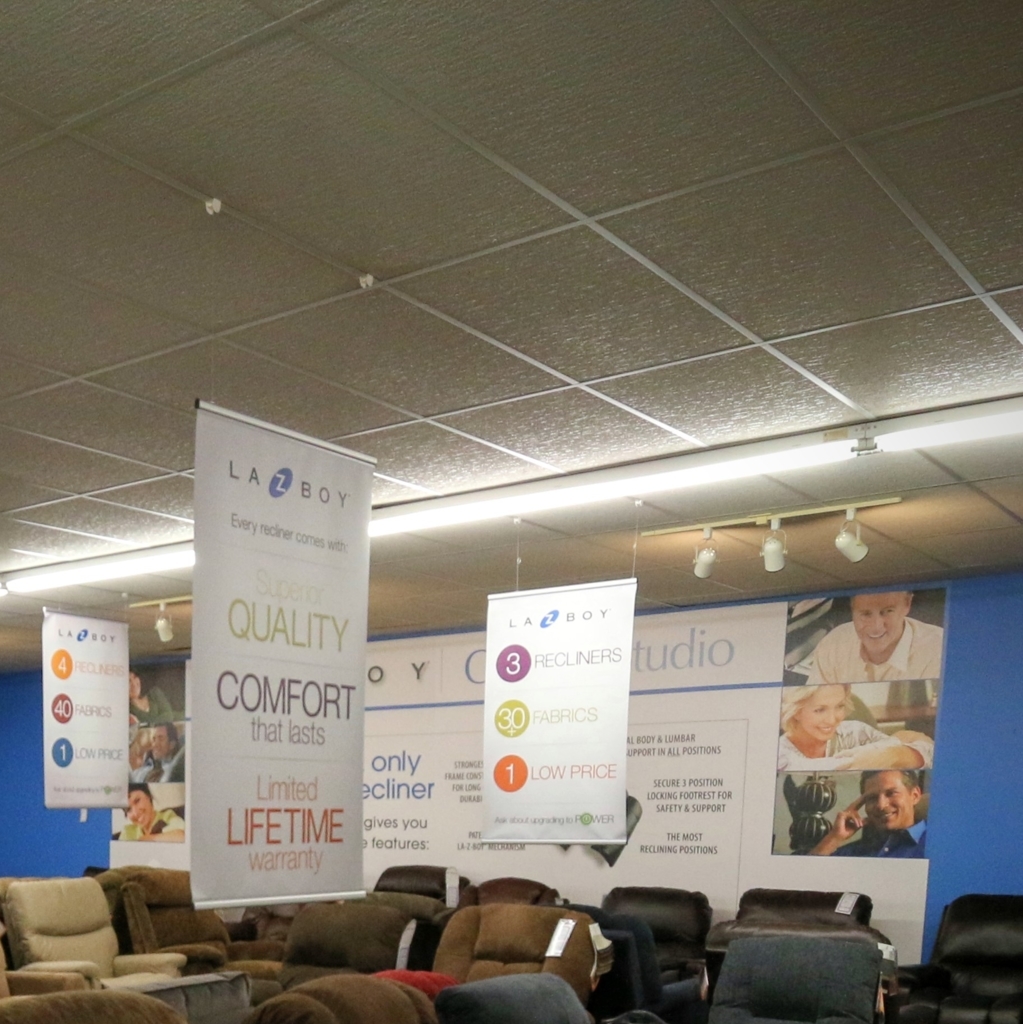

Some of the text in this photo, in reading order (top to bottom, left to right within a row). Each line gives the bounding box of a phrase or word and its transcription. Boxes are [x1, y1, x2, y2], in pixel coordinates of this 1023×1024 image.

[231, 513, 349, 554] Every recliner comes with:
[228, 598, 349, 652] QUALITY
[633, 627, 735, 673] tudio
[57, 656, 125, 678] 4 RECLINERS
[506, 652, 521, 675] 3
[534, 647, 623, 669] RECLINERS
[216, 670, 357, 720] COMFORT
[54, 699, 112, 718] 40 FABRICS
[533, 707, 598, 724] FABRICS
[251, 716, 326, 746] that lasts
[636, 735, 656, 745] BODY
[665, 733, 696, 744] LUMBAR
[59, 744, 123, 761] 1 LOW PRICE
[658, 747, 666, 756] IN
[667, 747, 680, 757] ALL
[682, 746, 722, 756] POSITIONS
[371, 749, 422, 777] only
[445, 772, 464, 781] FRAME
[505, 763, 618, 785] 1 LOW PRICE
[256, 775, 318, 801] Limited
[362, 778, 435, 800] ecliner
[452, 783, 482, 792] FOR LONG
[653, 778, 724, 788] SECURE 3 POSITION
[647, 791, 733, 801] LOCKING FOOTREST FOR
[656, 803, 683, 813] SAFETY
[692, 803, 726, 813] SUPPORT
[228, 807, 345, 846] LIFETIME
[363, 816, 428, 831] gives you
[494, 816, 509, 824] Ask
[509, 816, 529, 824] about
[372, 837, 430, 851] features:
[667, 833, 703, 842] THE MOST
[488, 843, 526, 851] MECHANISM
[640, 845, 718, 855] RECLINING POSITIONS
[249, 847, 324, 875] warranty
